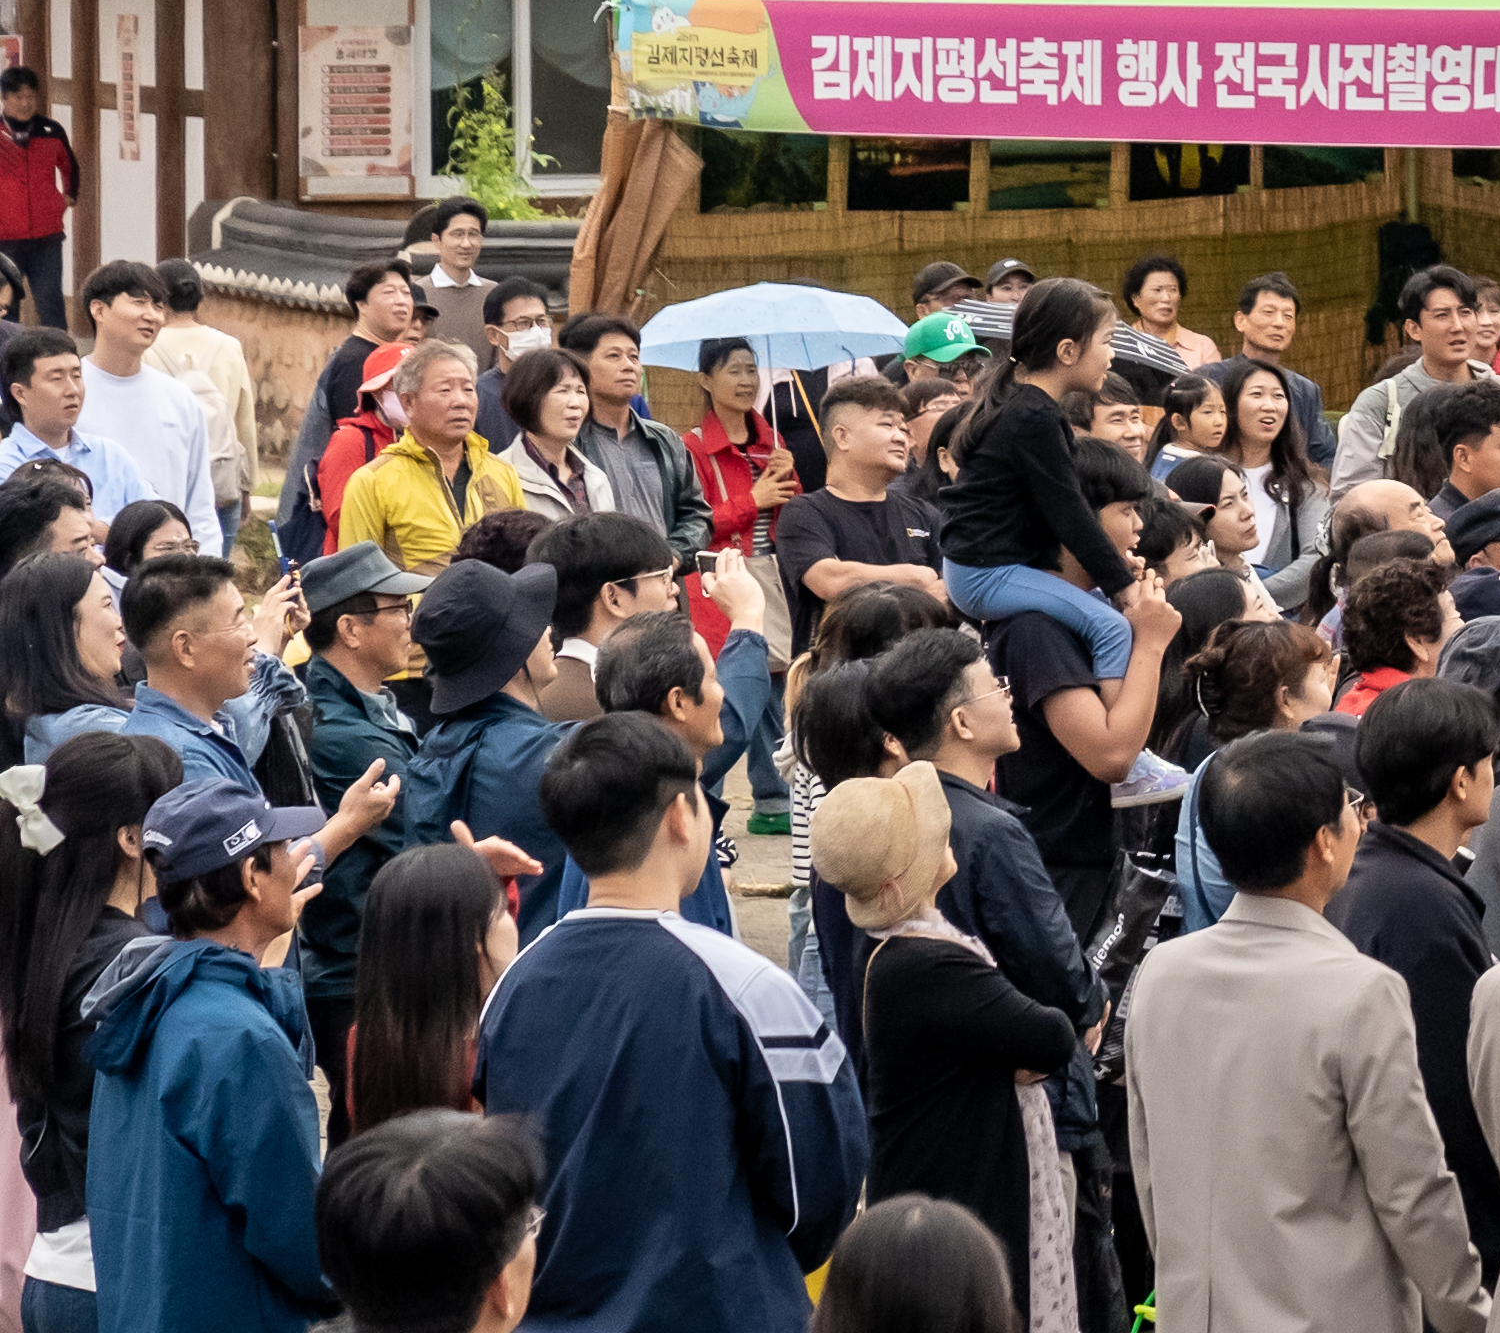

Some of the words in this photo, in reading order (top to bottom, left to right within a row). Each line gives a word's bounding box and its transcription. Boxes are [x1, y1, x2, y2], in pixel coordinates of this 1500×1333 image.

[647, 44, 758, 68] 김제지평선축제
[810, 34, 1102, 107] 김제지평선축제
[1116, 38, 1201, 110] 행사
